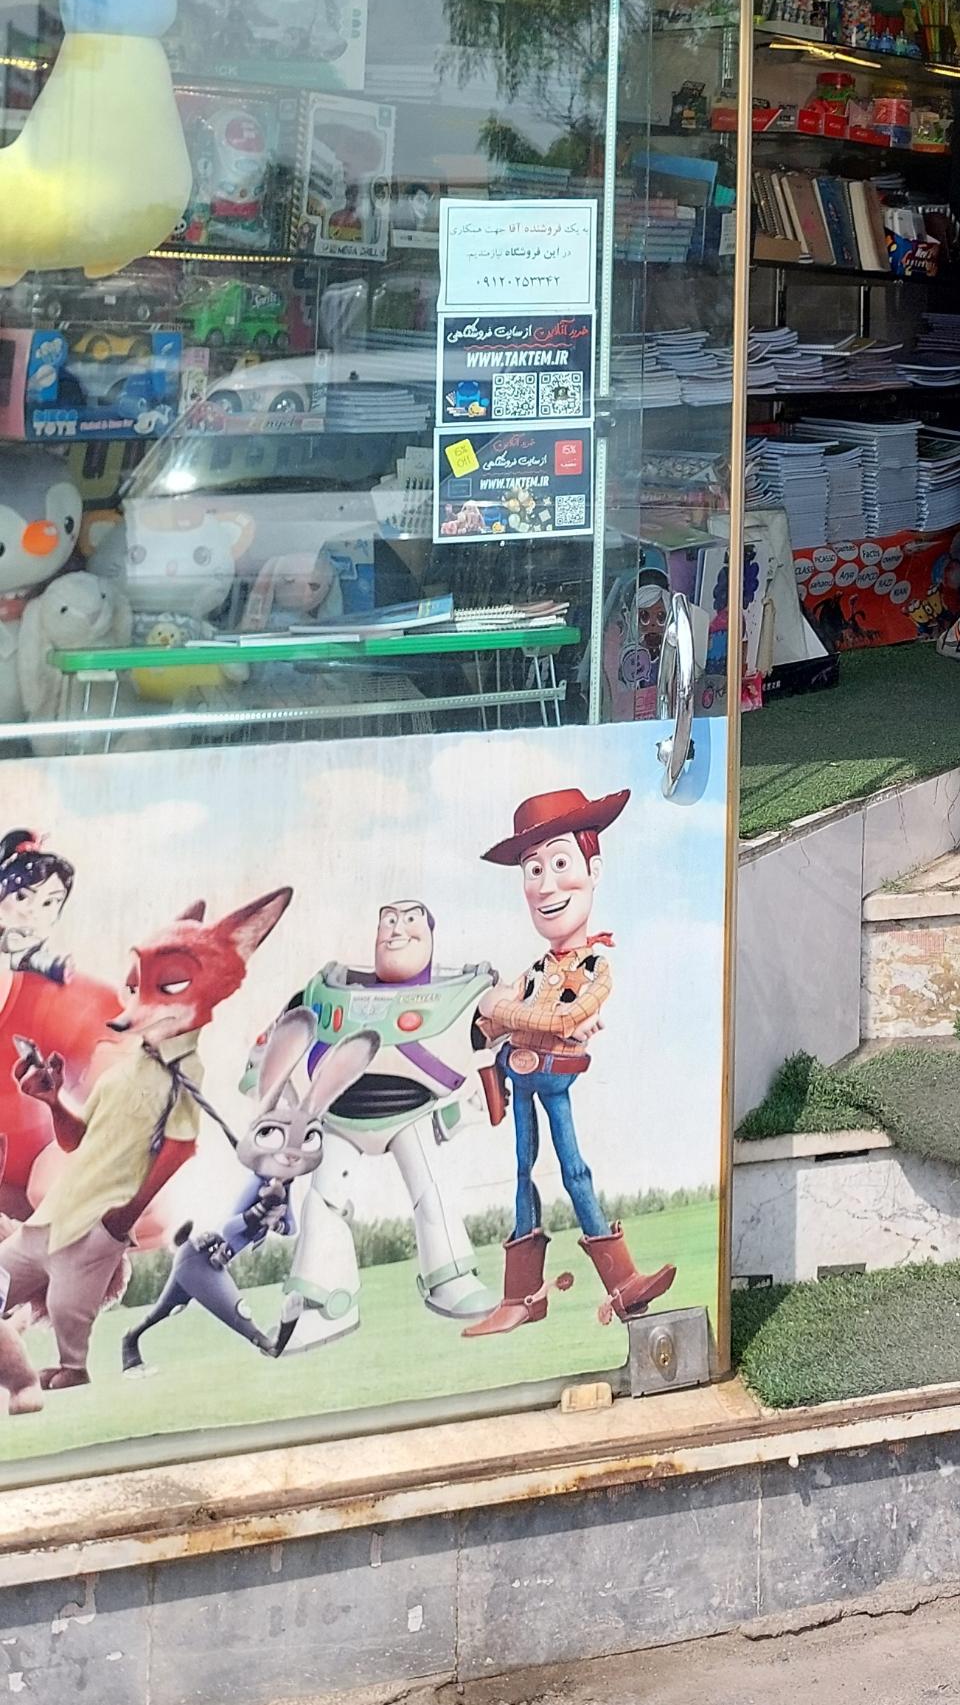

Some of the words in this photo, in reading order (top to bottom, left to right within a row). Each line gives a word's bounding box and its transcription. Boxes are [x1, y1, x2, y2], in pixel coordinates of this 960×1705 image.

[508, 222, 520, 234] آقا
[524, 224, 561, 236] فروشنده
[504, 247, 541, 260] فروشگاه
[543, 247, 560, 259] این
[466, 349, 569, 368] WWW.TAKTEM.IR
[479, 475, 550, 490] WWW.TAKTEM.IR
